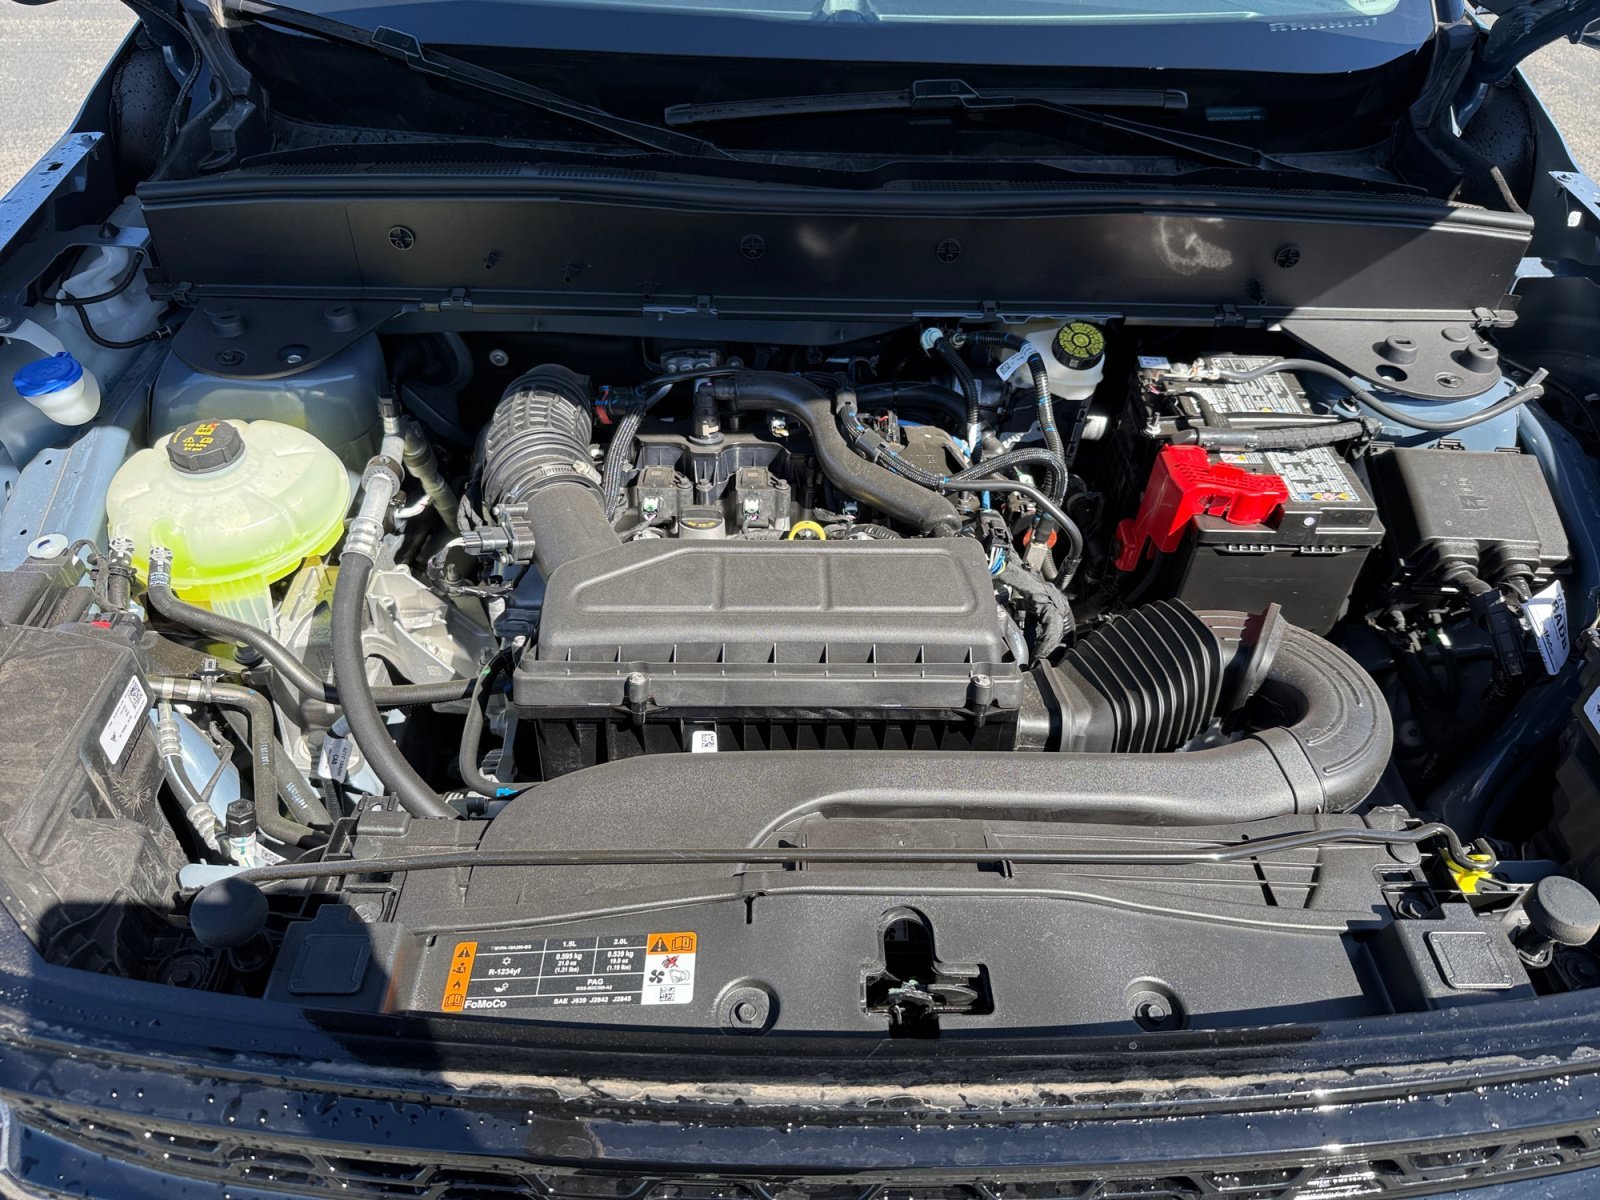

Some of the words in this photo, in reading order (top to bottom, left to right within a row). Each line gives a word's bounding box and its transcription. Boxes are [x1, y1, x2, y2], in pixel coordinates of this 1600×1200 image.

[1552, 599, 1566, 650] RADB
[488, 967, 521, 976] R-1234yf
[464, 998, 507, 1009] FoMoCo
